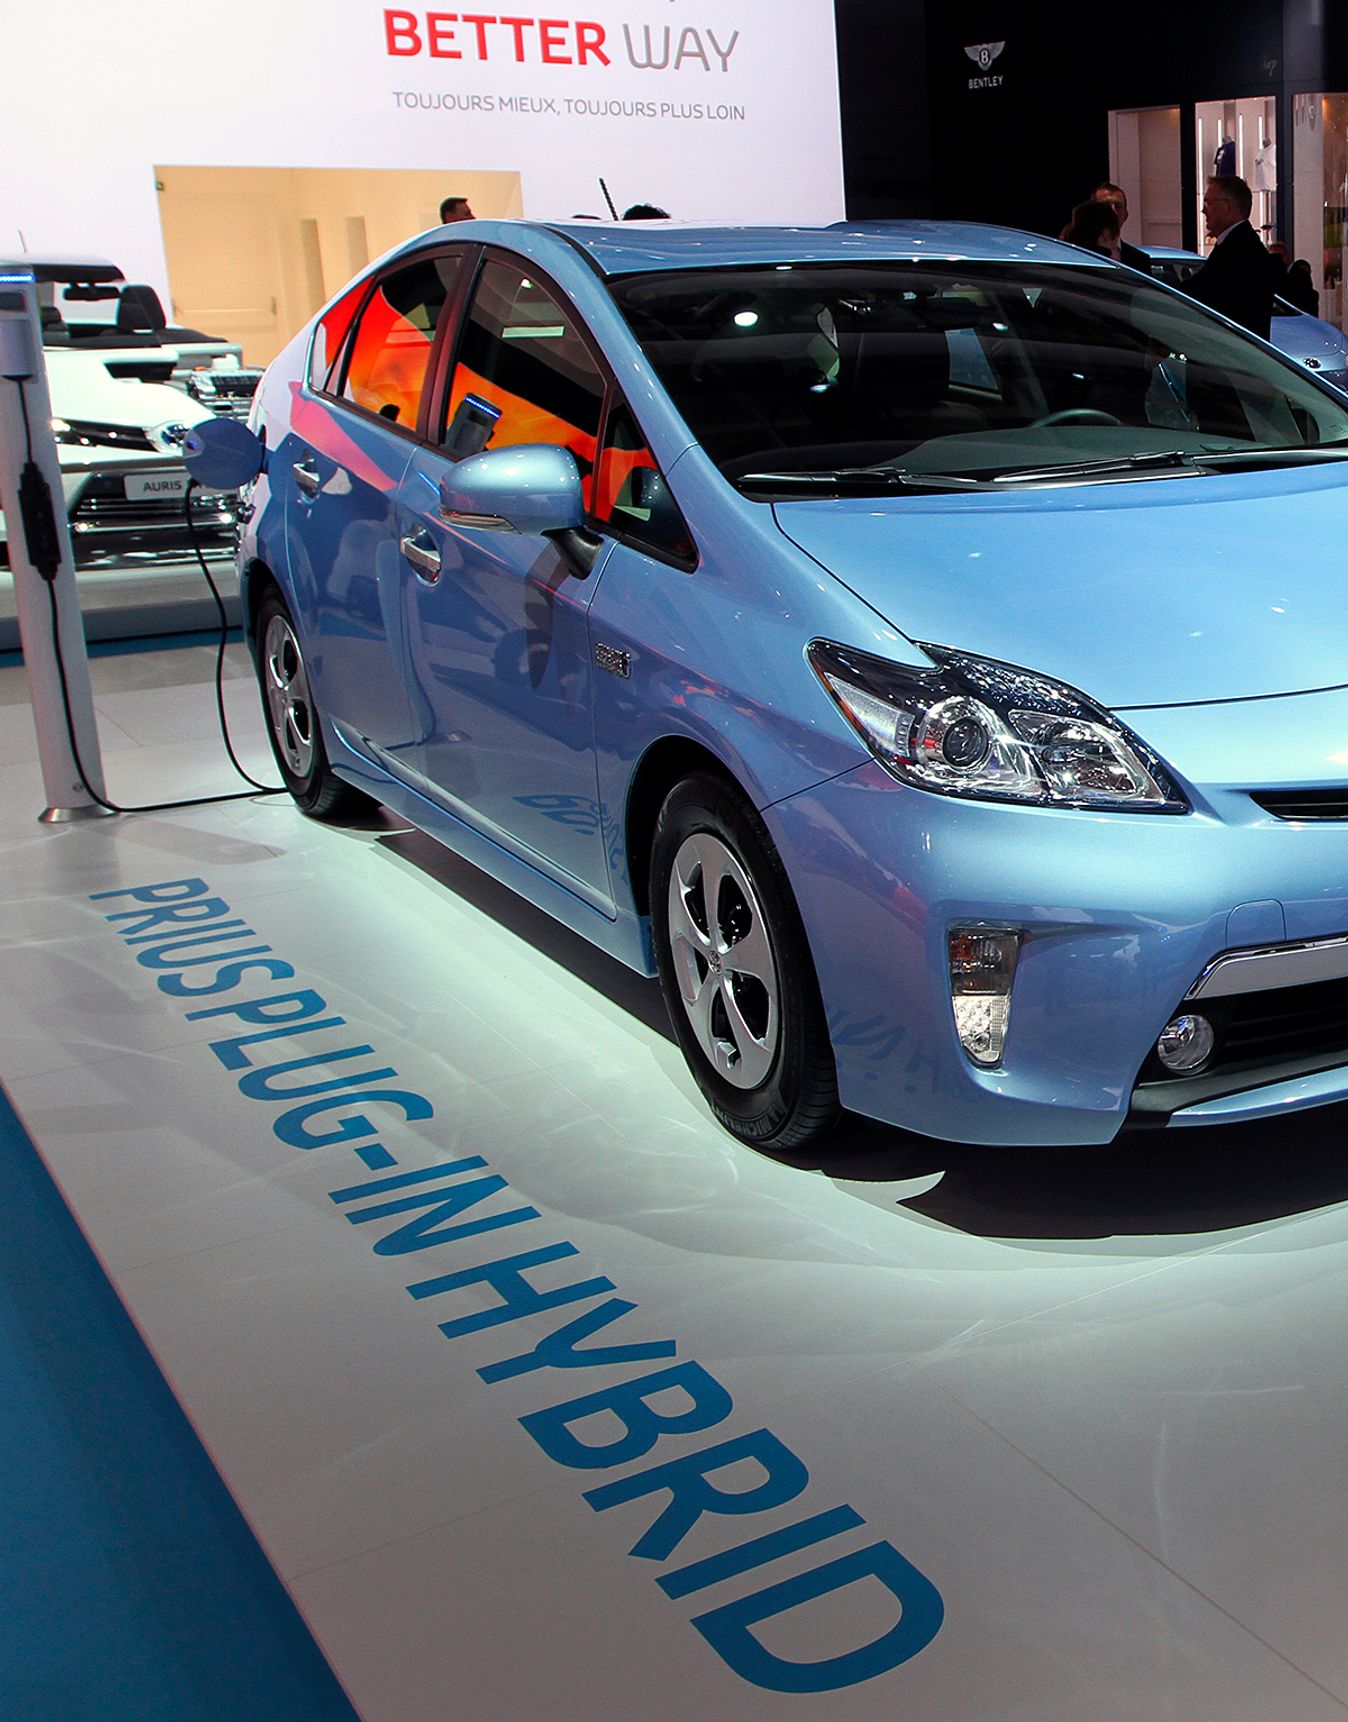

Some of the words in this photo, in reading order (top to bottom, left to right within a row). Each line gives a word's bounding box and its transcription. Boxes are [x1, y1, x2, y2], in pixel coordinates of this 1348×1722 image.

[383, 9, 611, 66] BETTER
[622, 23, 739, 72] WAY
[392, 91, 495, 111] TOUJOURS
[499, 96, 561, 116] MIEUX,
[564, 99, 657, 118] TOUJOURS
[661, 103, 703, 119] PLUS
[707, 104, 745, 120] LOIN
[969, 75, 1004, 89] BENTLEY
[143, 481, 182, 492] AURIS
[88, 877, 295, 998] PRIUS
[184, 988, 542, 1256] PLUG-IN
[405, 1240, 945, 1694] HYBRID
